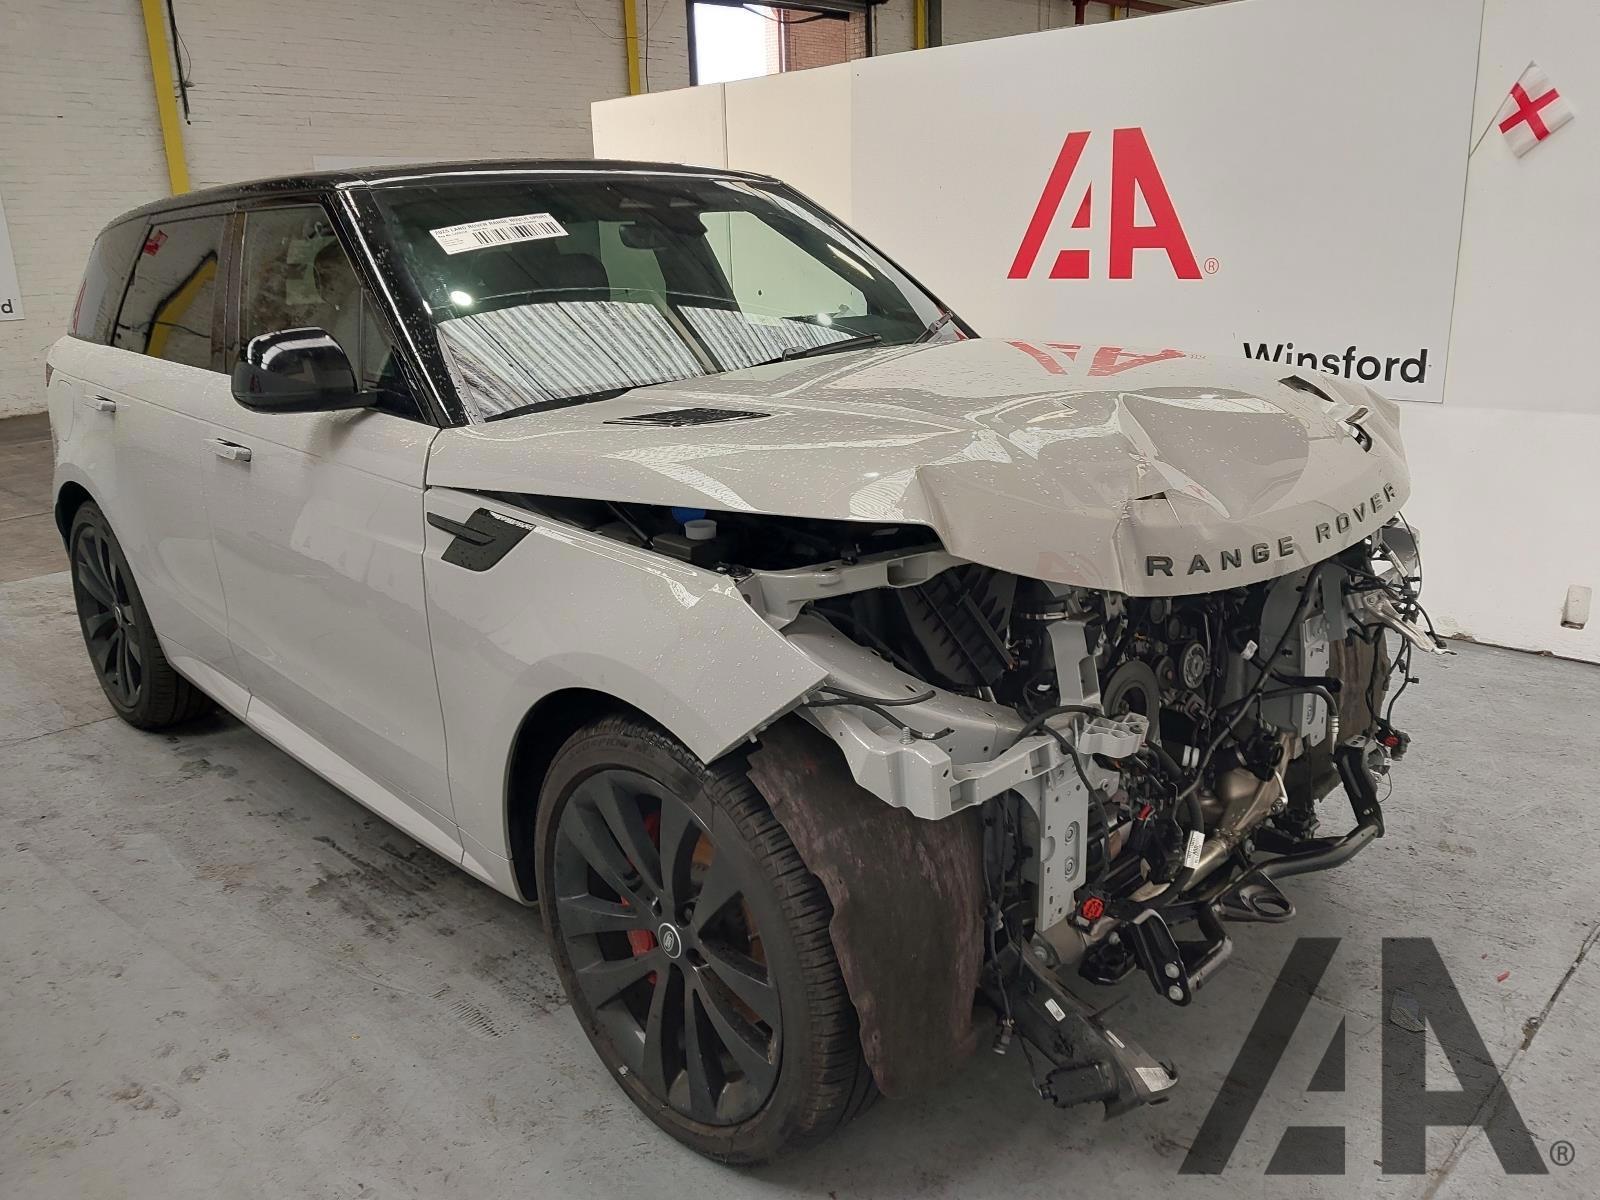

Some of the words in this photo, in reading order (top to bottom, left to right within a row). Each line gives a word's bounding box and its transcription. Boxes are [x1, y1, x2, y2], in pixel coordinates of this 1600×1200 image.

[1242, 342, 1428, 384] Winsford
[1145, 535, 1296, 577] RANGE
[1314, 482, 1397, 544] ROVER
